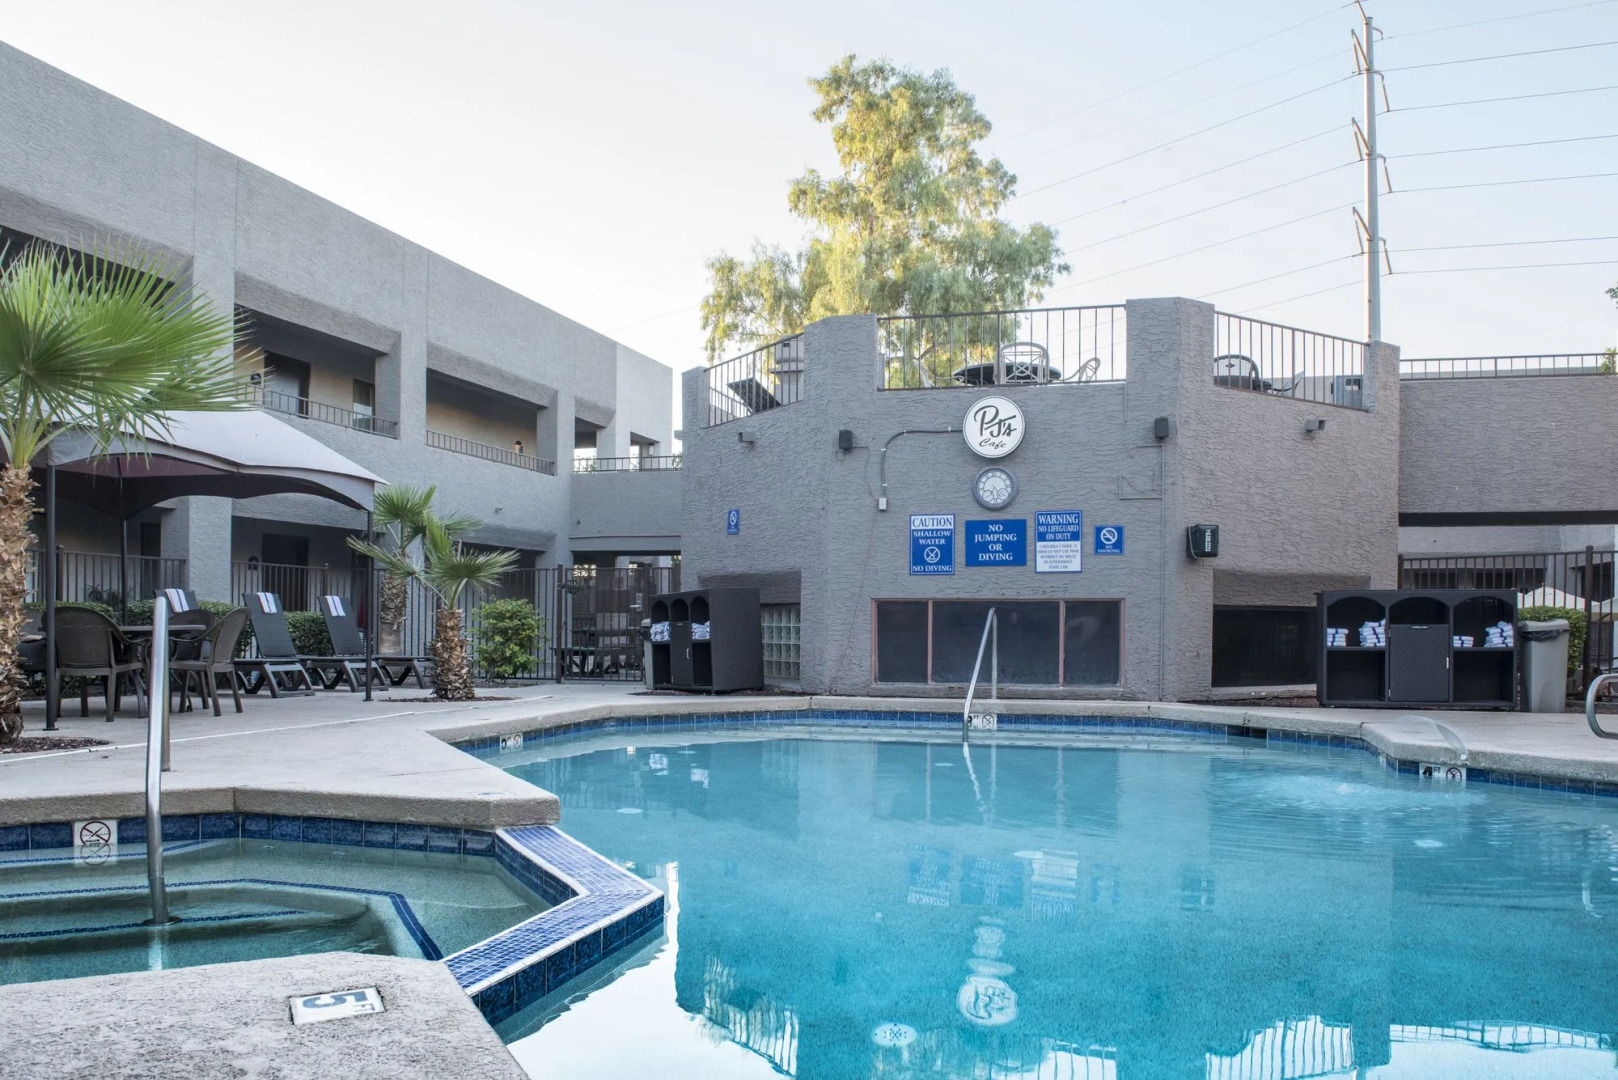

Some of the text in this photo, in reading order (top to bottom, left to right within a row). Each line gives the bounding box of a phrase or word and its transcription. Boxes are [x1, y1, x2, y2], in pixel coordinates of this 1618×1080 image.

[974, 405, 1017, 437] PJ's
[912, 518, 952, 527] CAUTION
[1038, 514, 1078, 524] WARNING
[988, 524, 1003, 532] NO
[974, 534, 1016, 544] JUMPING
[988, 543, 1002, 551] OR
[302, 990, 368, 1008] 5
